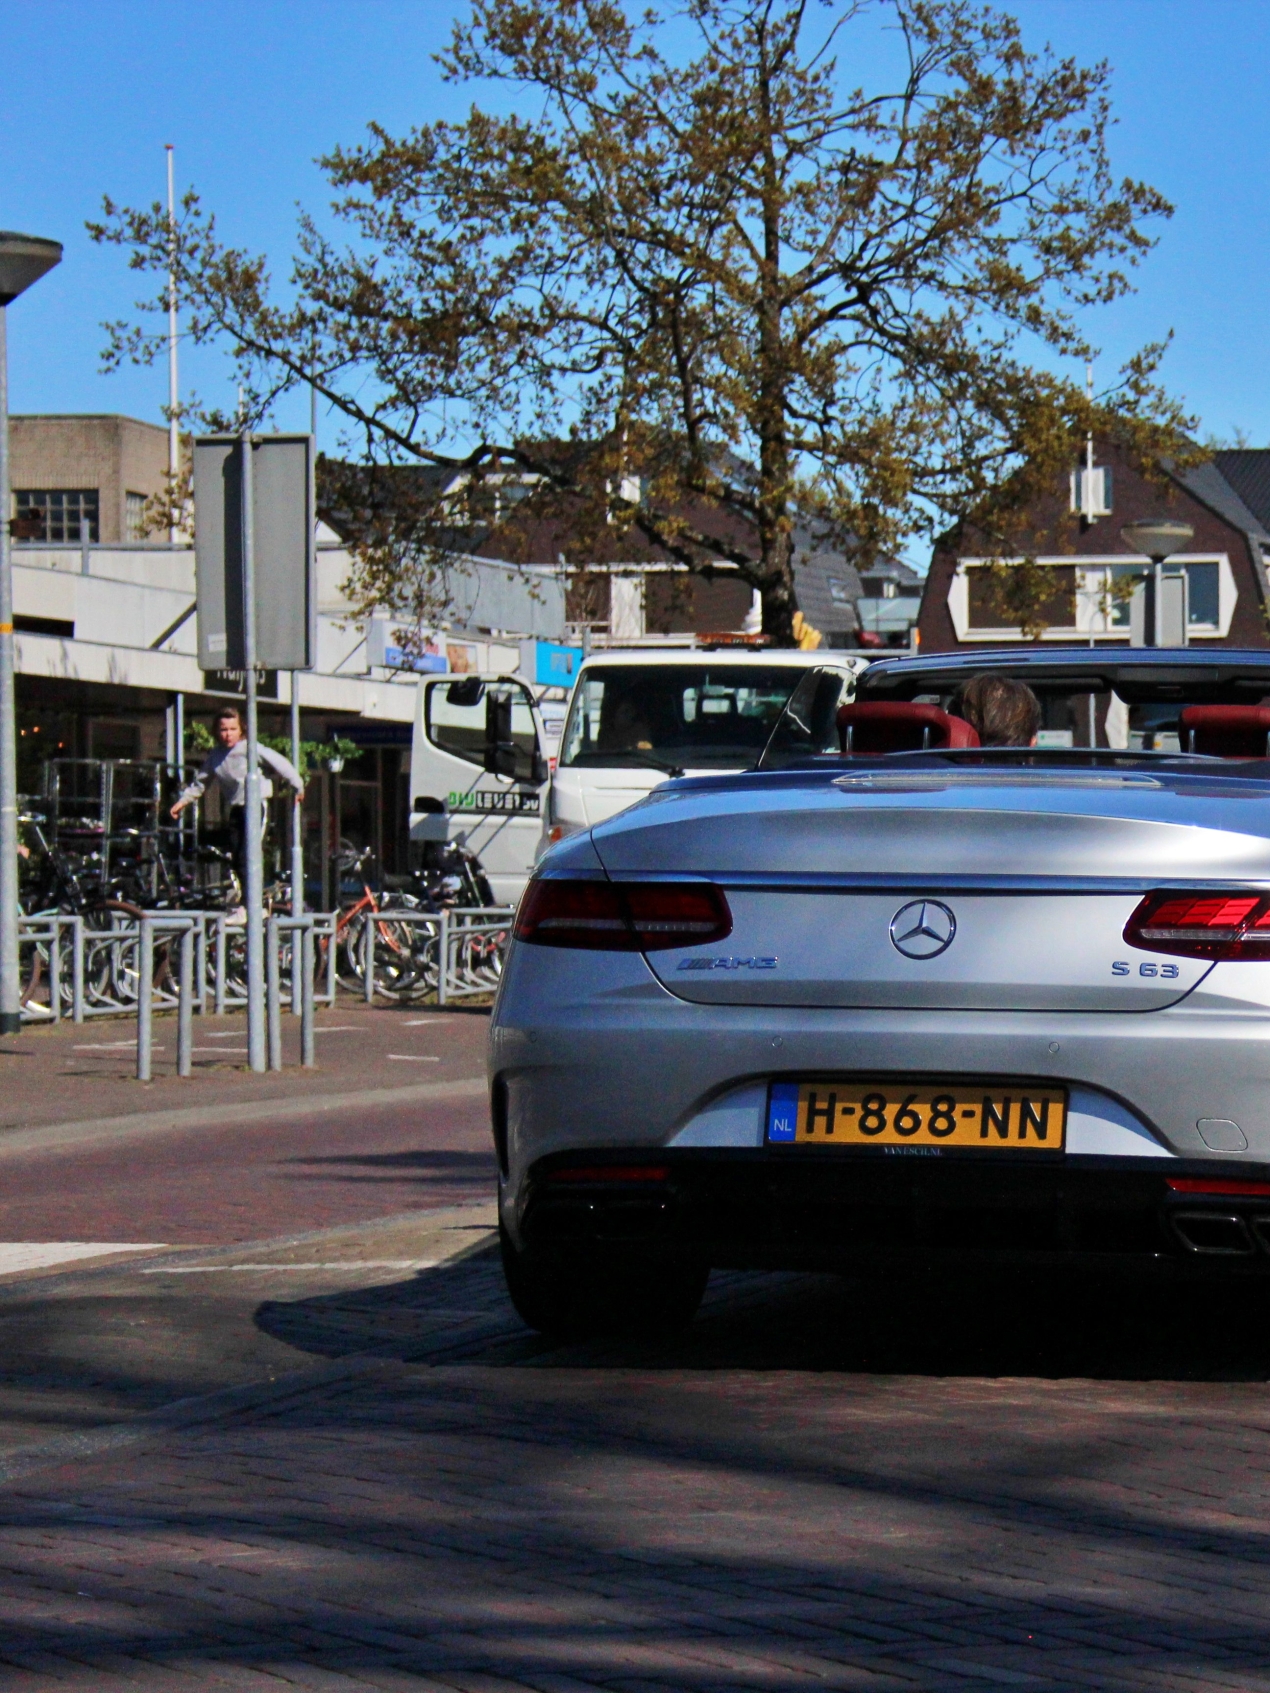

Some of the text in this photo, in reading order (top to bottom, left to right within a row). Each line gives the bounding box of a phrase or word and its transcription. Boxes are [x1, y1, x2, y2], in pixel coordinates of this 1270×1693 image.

[713, 957, 777, 969] AMG
[1111, 961, 1180, 979] S 63
[805, 1091, 1050, 1141] H-868-NN
[773, 1118, 792, 1132] NL
